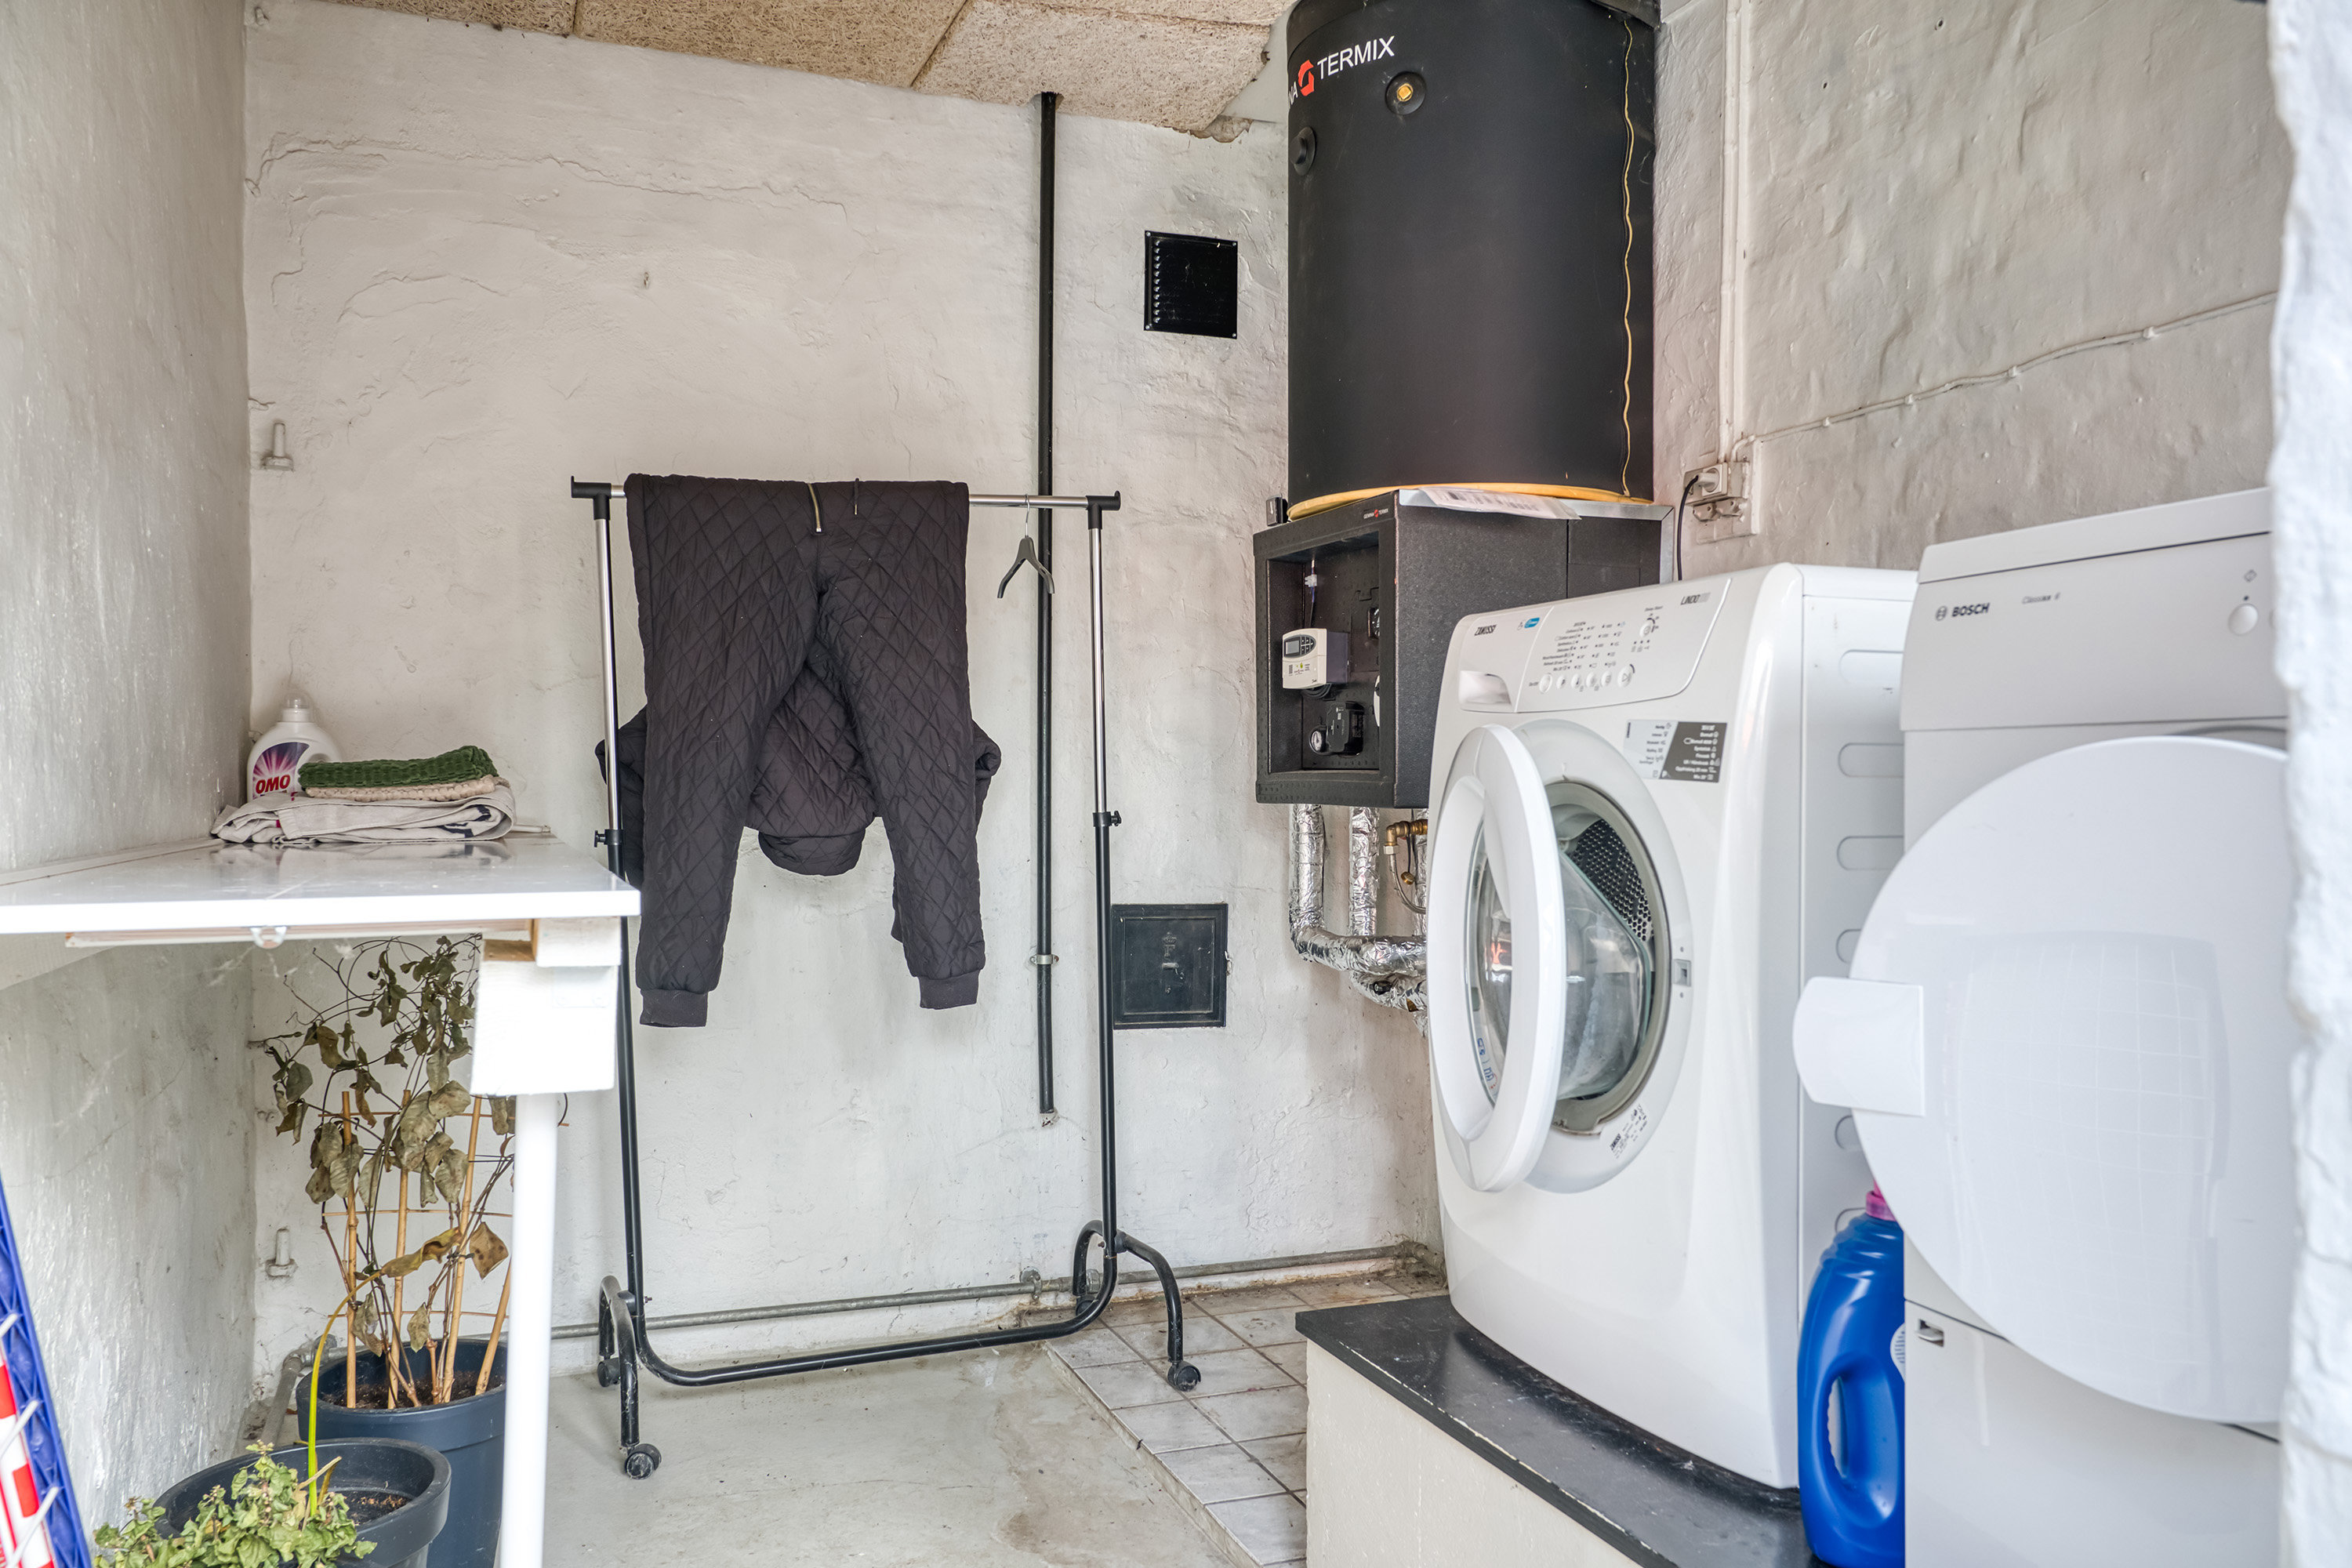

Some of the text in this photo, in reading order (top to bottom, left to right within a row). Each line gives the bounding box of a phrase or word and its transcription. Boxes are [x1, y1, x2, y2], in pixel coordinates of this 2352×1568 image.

[1316, 35, 1396, 80] TERMIX
[1951, 602, 1991, 618] BOSCH
[256, 774, 291, 794] OMO
